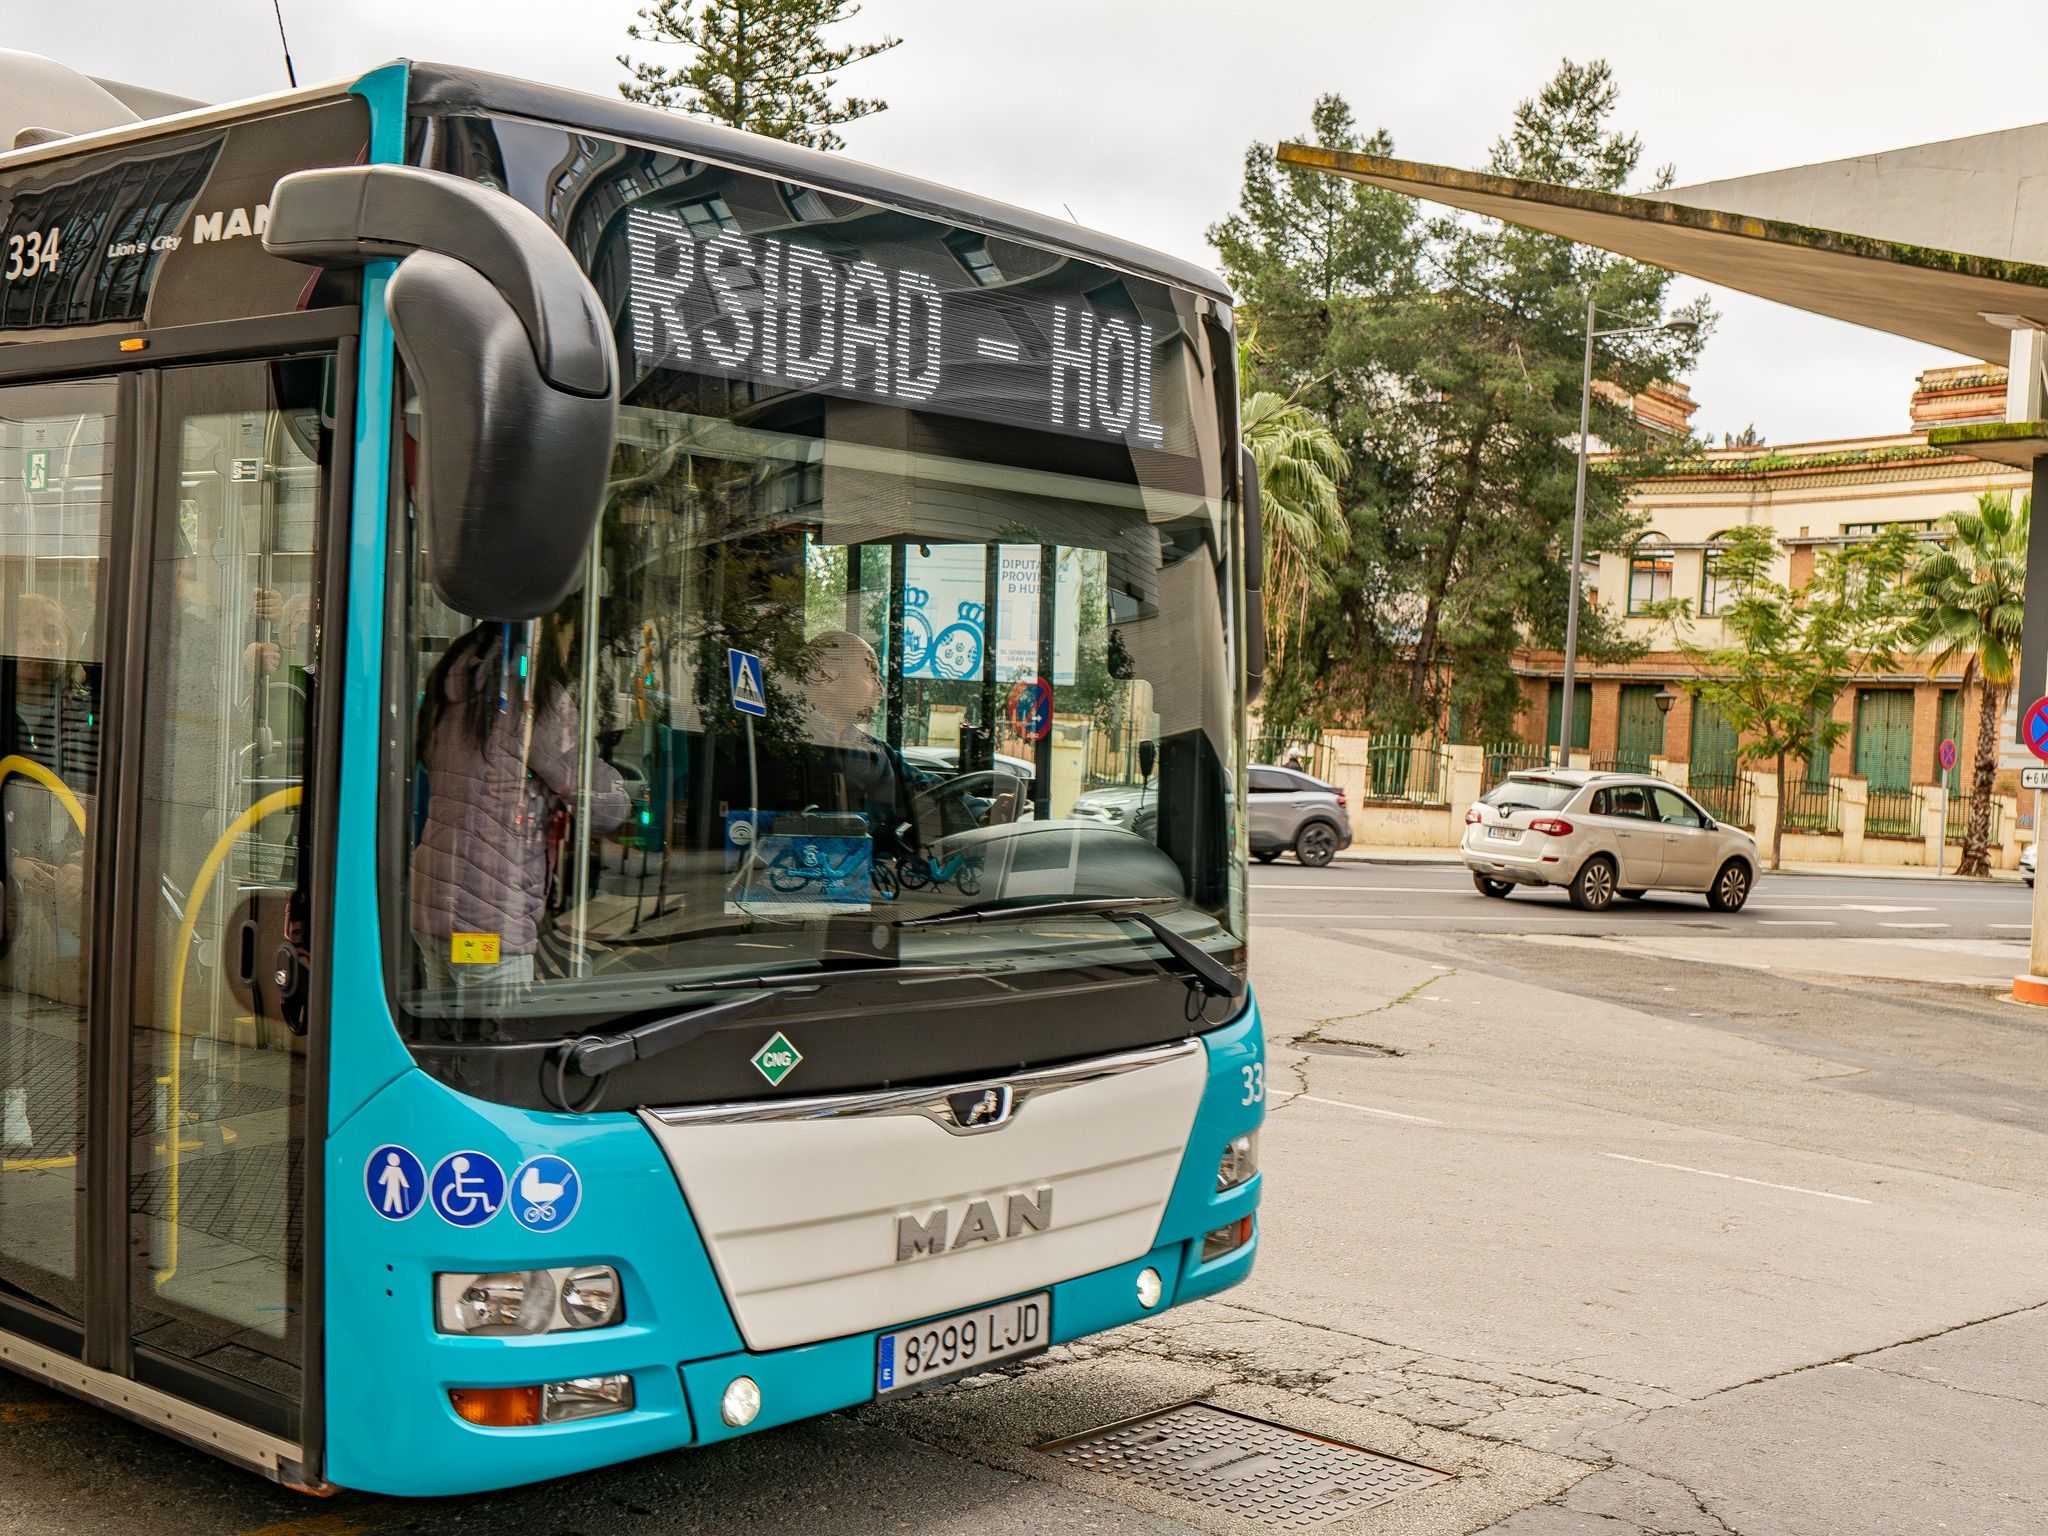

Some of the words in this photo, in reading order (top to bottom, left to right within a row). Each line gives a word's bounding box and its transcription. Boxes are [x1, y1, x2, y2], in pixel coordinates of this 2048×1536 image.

[5, 227, 60, 281] 334
[107, 239, 147, 258] Lion's
[150, 235, 182, 251] City
[627, 207, 943, 400] RSIDAD
[1051, 304, 1164, 442] HOL
[2034, 772, 2039, 785] 6
[762, 1051, 792, 1068] CNG
[895, 1184, 1054, 1263] MAN
[904, 1319, 977, 1376] 8299
[989, 1303, 1039, 1354] LJD
